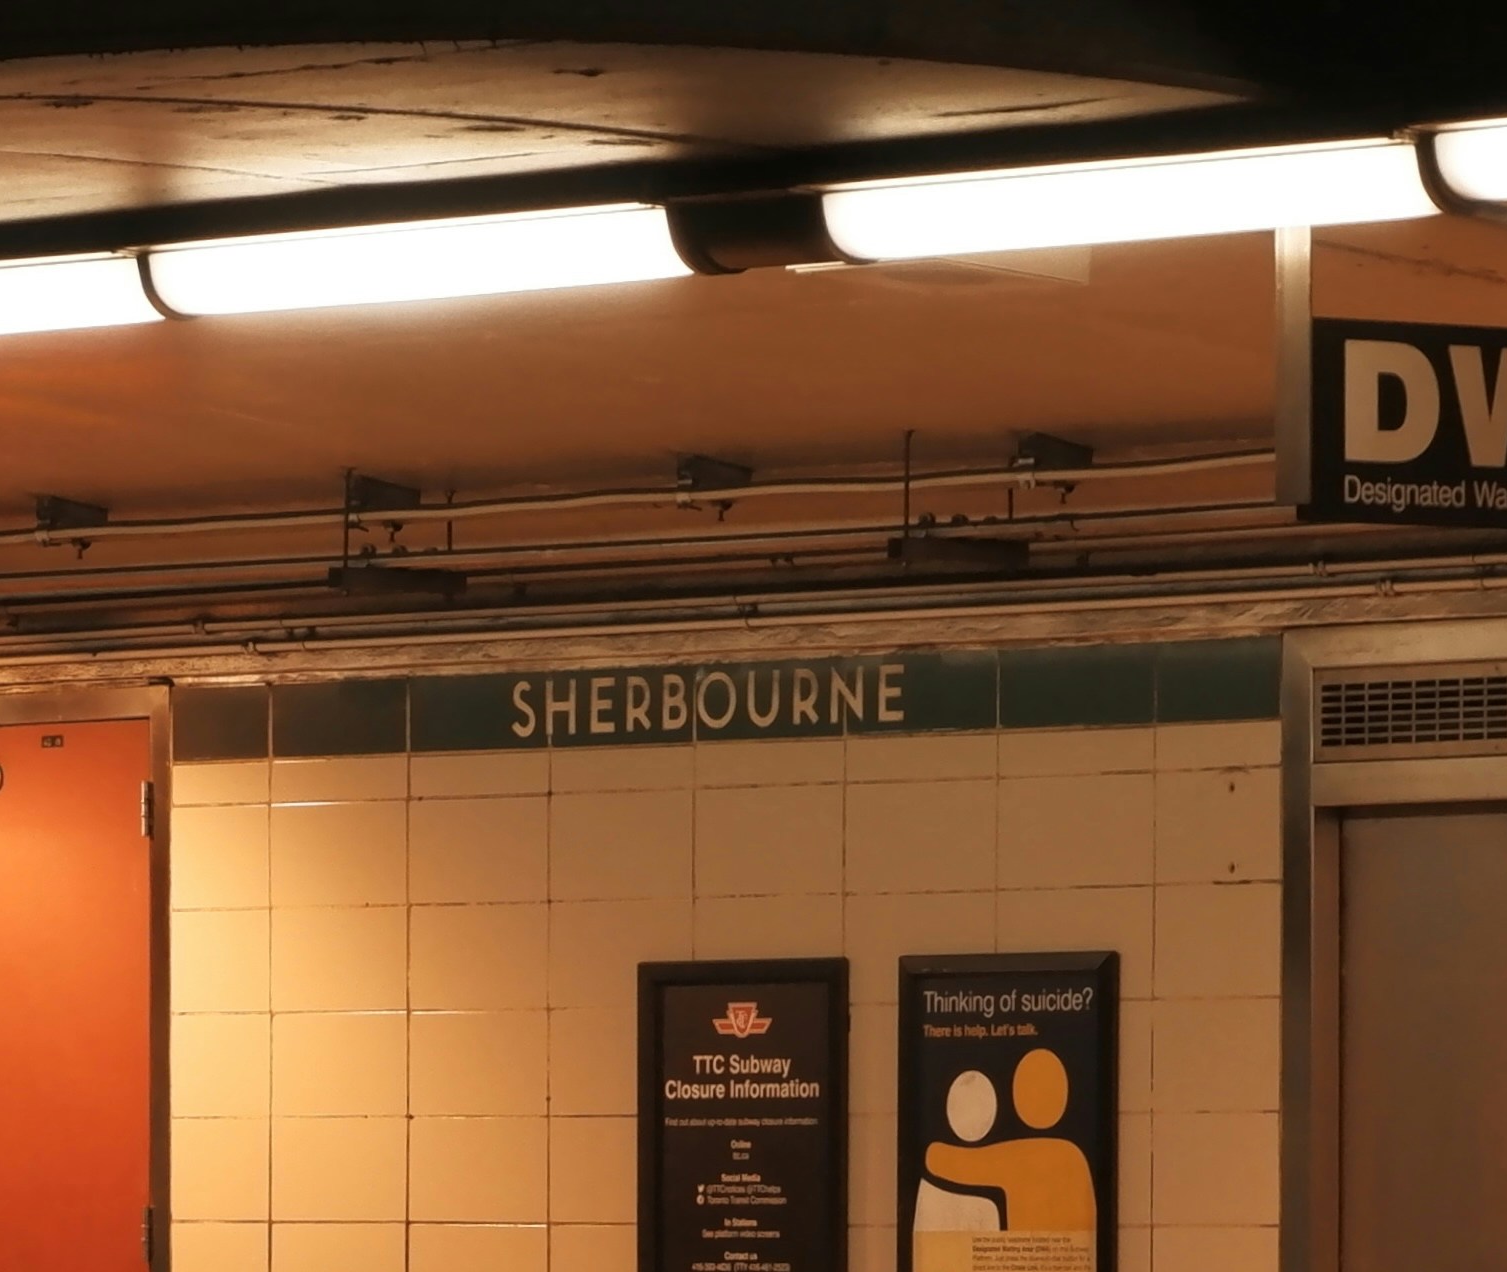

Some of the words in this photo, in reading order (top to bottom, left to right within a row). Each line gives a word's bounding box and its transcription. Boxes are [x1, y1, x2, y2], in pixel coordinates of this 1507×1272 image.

[1344, 474, 1466, 513] Designated
[511, 664, 905, 738] SHERBOURNE
[923, 990, 995, 1018] Thinking
[999, 989, 1017, 1012] of
[1021, 987, 1093, 1012] suicide?
[923, 1024, 952, 1037] There
[953, 1024, 962, 1037] is
[964, 1024, 988, 1039] help.
[991, 1023, 1015, 1037] Let's
[1017, 1023, 1038, 1036] talk.
[693, 1054, 725, 1075] TTC
[729, 1054, 792, 1079] Subway
[665, 1079, 726, 1099] Closure
[729, 1078, 820, 1098] Information
[730, 1140, 752, 1149] Online
[721, 1173, 741, 1182] Social
[741, 1173, 761, 1182] Media
[730, 1195, 750, 1204] Transit
[750, 1195, 787, 1205] Commission
[732, 1217, 758, 1227] Stations
[724, 1251, 749, 1260] Contact
[749, 1252, 758, 1260] us
